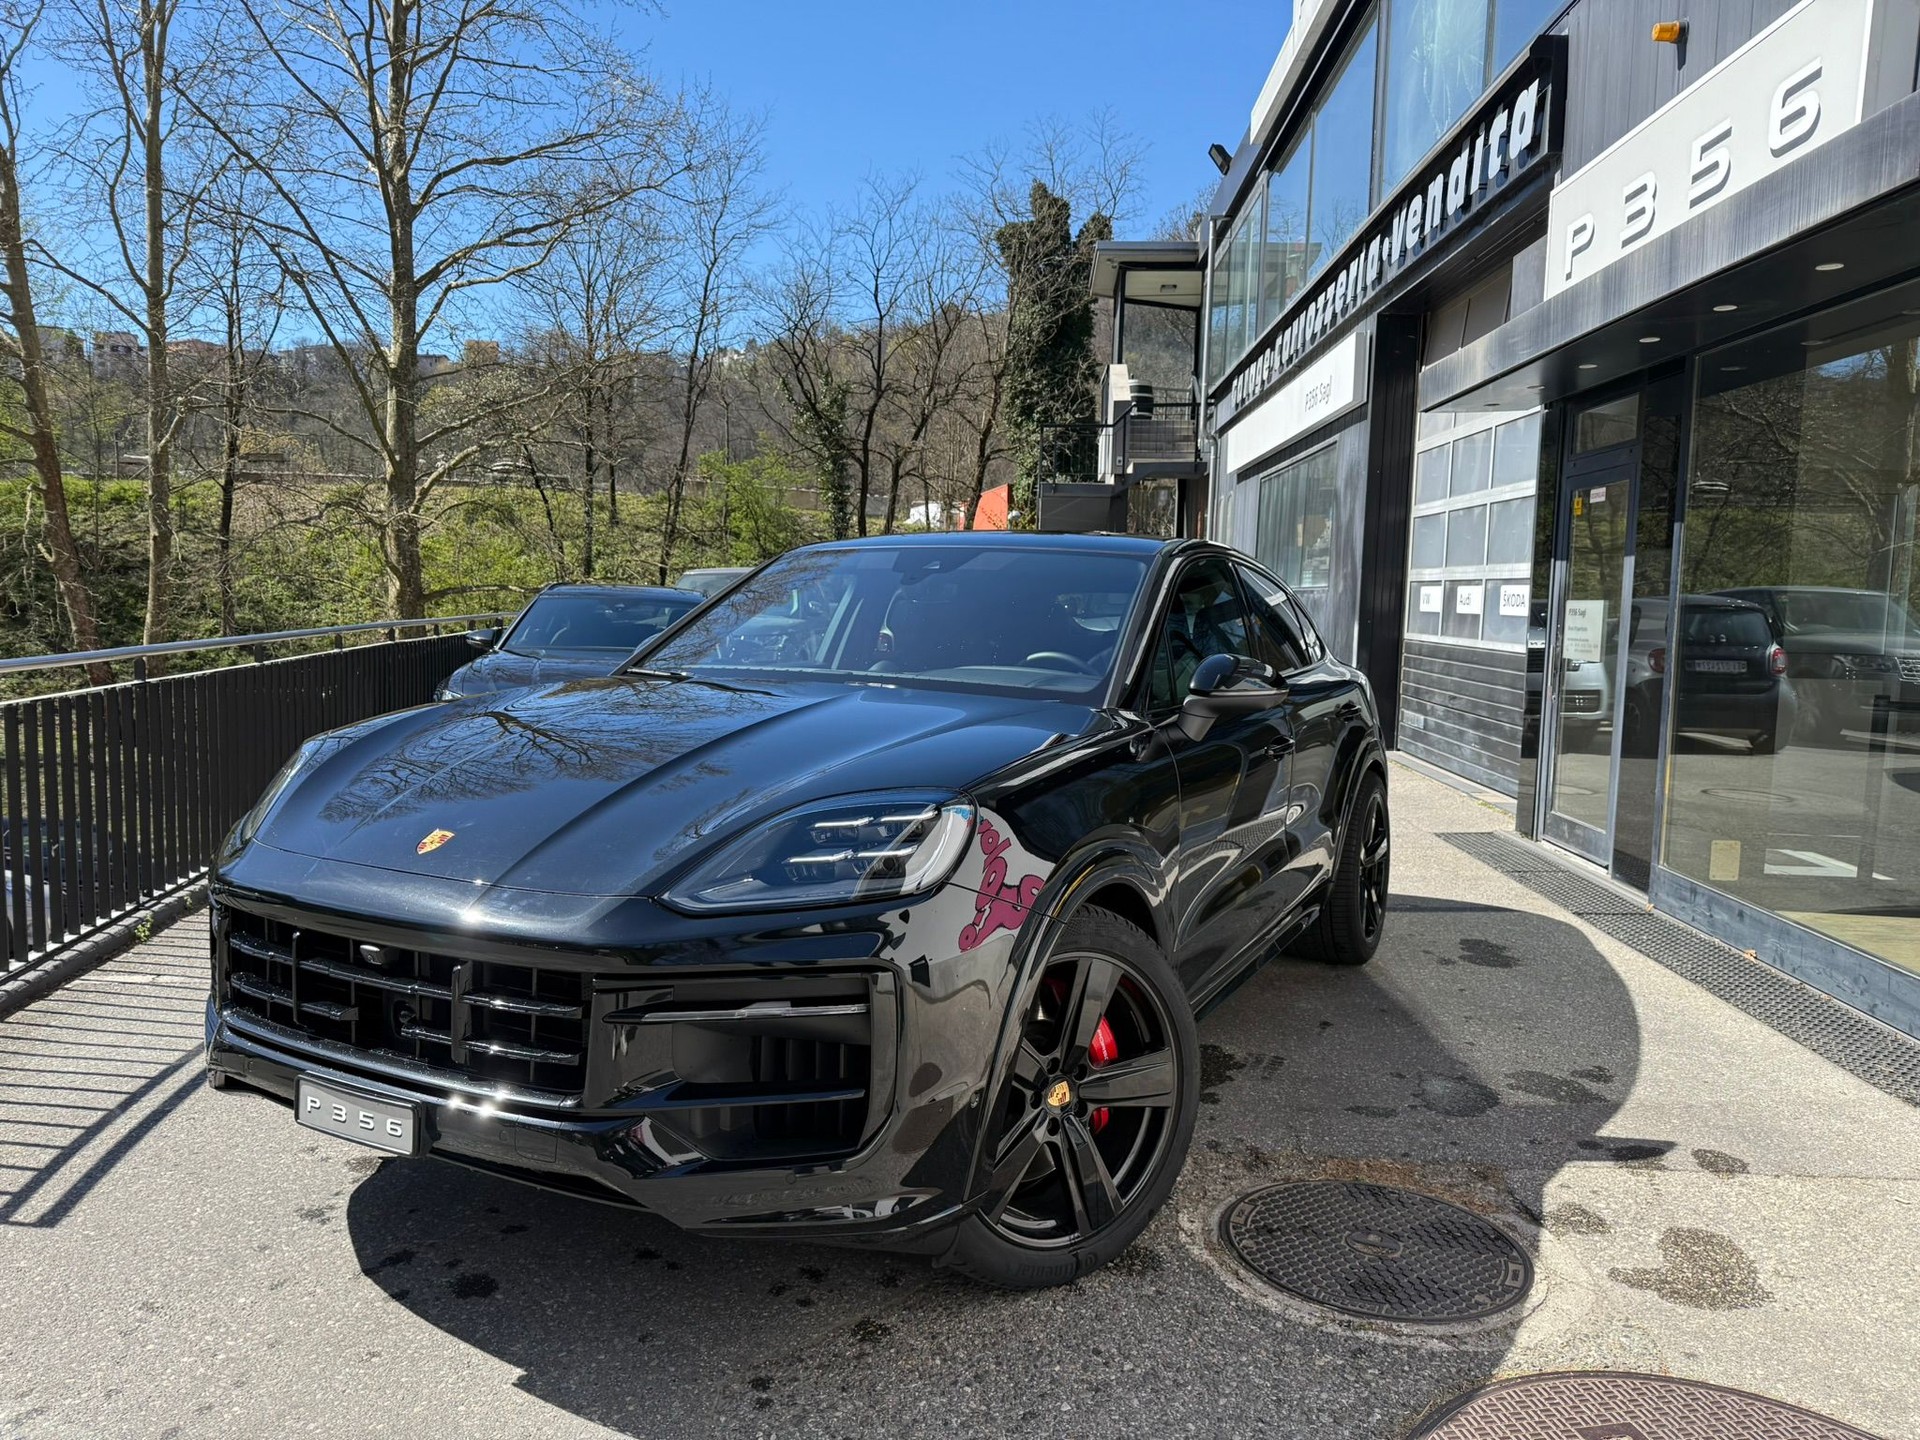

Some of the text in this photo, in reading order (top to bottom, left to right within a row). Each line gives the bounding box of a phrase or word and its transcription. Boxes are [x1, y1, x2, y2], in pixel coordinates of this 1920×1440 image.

[1274, 234, 1382, 370] carrozzeria
[1391, 78, 1540, 264] vendita
[1458, 593, 1472, 606] Audi
